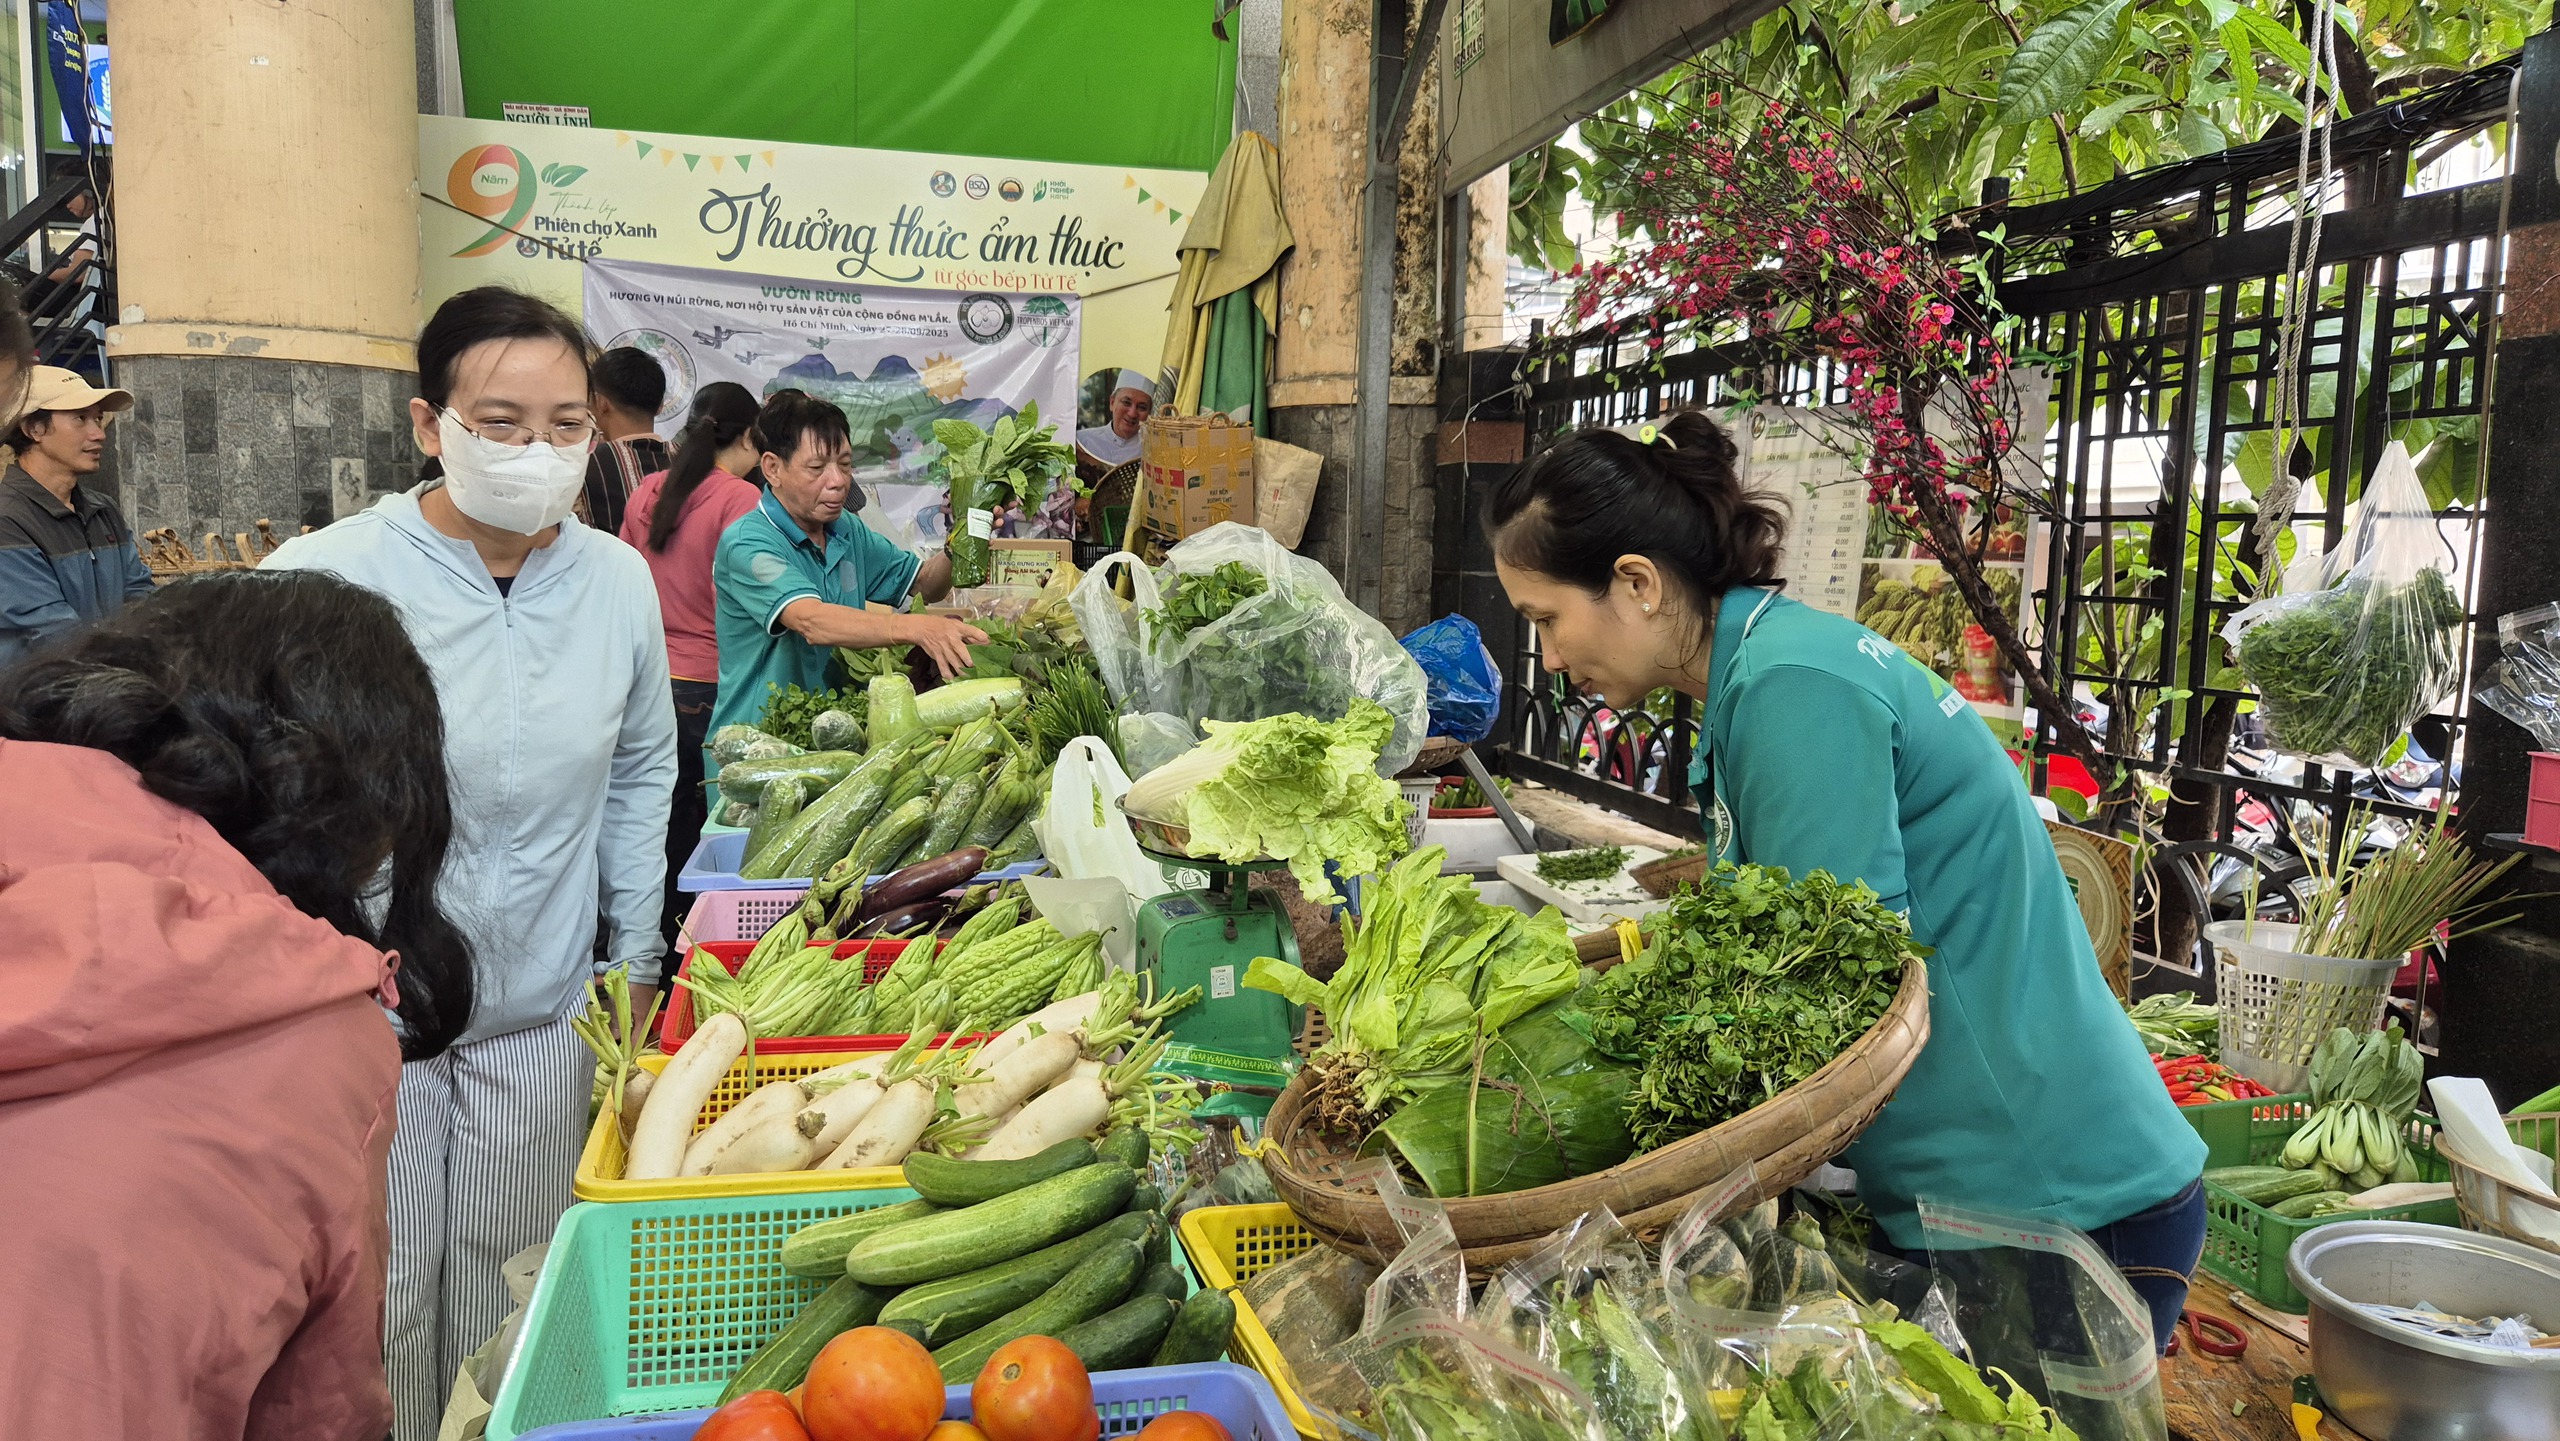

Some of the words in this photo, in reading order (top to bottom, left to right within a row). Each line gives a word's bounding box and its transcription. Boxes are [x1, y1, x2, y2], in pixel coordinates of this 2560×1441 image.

[481, 174, 508, 185] Năm
[534, 215, 581, 233] Phiên
[583, 219, 613, 239] chợ
[614, 221, 658, 239] Xanh
[699, 182, 924, 282] Thưởng
[888, 203, 970, 260] thức
[978, 215, 1040, 265] ẩm
[1049, 213, 1127, 277] thực
[541, 236, 576, 260] Tử
[577, 236, 603, 258] tế
[935, 269, 952, 284] từ
[956, 271, 989, 291] góc
[993, 269, 1028, 292] bếp
[1031, 273, 1053, 290] Tử
[1056, 273, 1078, 291] Tế
[761, 284, 811, 301] VƯỜN
[815, 289, 862, 305] RỪNG
[609, 291, 651, 304] HƯƠNG
[653, 294, 665, 308] VỊ
[667, 292, 687, 306] NÚI
[689, 294, 724, 310] RỪNG,
[726, 299, 747, 311] NƠI
[749, 299, 768, 315] HỘI
[770, 304, 784, 316] TỤ
[786, 302, 807, 316] SẢN
[809, 303, 830, 319] VẬT
[832, 305, 852, 318] CỦA
[855, 307, 884, 321] CỘNG
[886, 307, 916, 323] ĐỒNG
[800, 319, 818, 330] Chí
[1400, 1207, 1421, 1218] TTT
[2018, 1232, 2055, 1246] TTT
